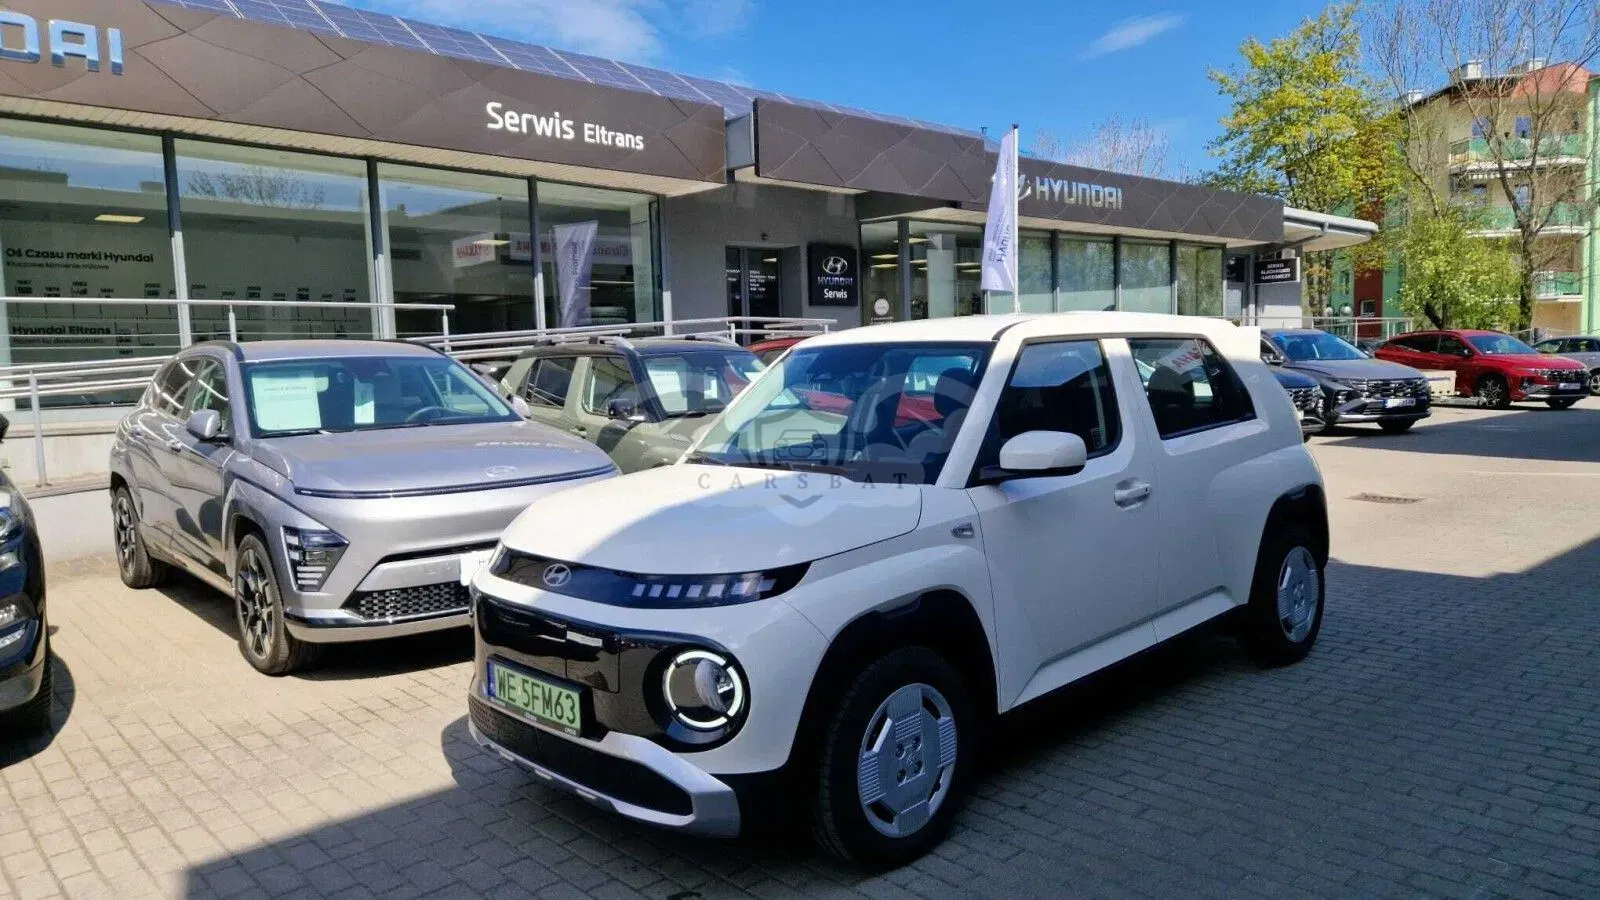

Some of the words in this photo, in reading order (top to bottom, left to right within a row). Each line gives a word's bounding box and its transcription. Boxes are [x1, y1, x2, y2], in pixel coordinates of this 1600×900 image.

[486, 101, 575, 140] Serwis
[583, 122, 645, 150] Eltrans
[1035, 176, 1122, 210] HYUNDAI
[25, 249, 64, 259] Czasu
[67, 250, 102, 260] marki
[104, 253, 154, 264] Hyundai
[817, 276, 853, 286] HYUNDAI
[823, 288, 848, 299] Serwis
[12, 326, 66, 336] Hyundai
[69, 325, 111, 335] Eltrans
[497, 668, 516, 703] WE
[521, 678, 576, 724] 5FM63
